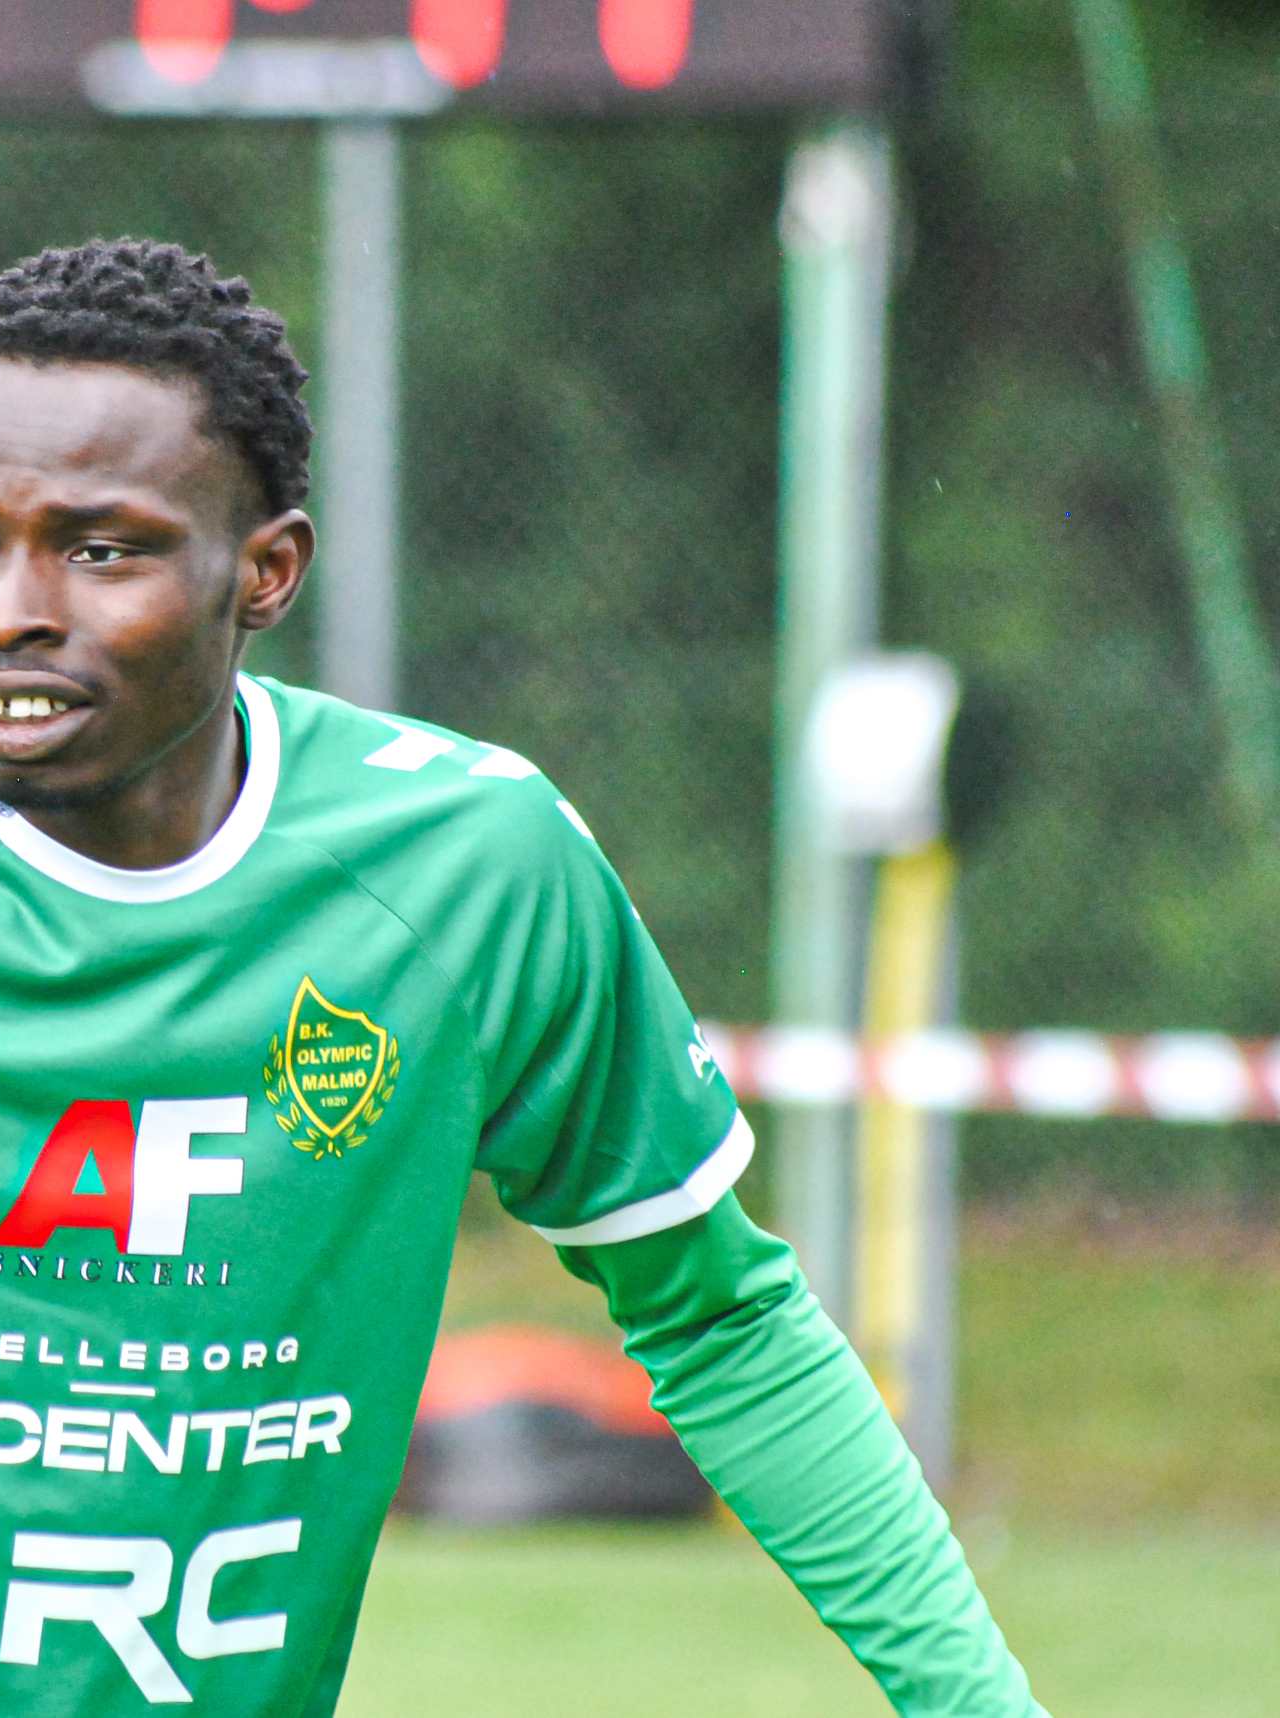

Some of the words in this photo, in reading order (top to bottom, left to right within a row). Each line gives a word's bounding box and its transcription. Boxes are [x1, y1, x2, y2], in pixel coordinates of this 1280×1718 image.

[299, 1022, 333, 1040] B.K.
[297, 1044, 373, 1065] OLYMPIC
[302, 1068, 367, 1091] MALMÖ
